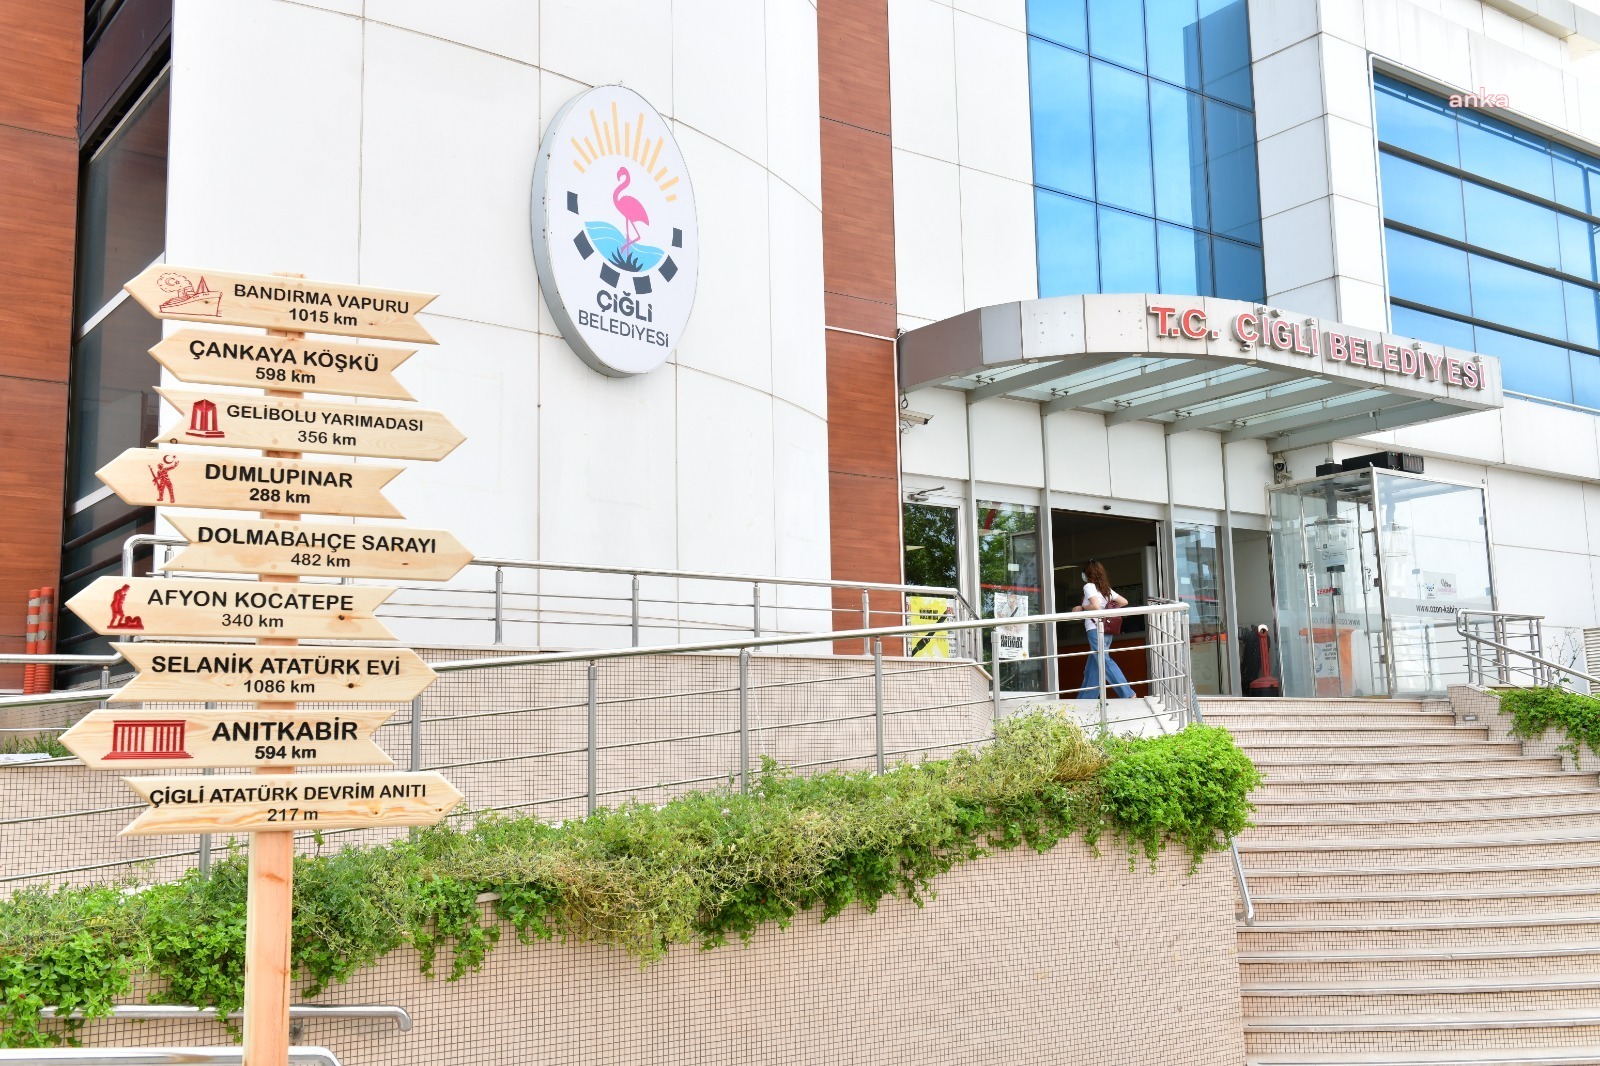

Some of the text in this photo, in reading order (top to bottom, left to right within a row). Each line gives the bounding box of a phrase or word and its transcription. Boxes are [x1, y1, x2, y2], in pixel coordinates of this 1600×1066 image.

[234, 283, 409, 314] BANDIRMA VAPURU
[597, 290, 652, 322] ÇİĞLİ
[288, 307, 358, 327] 1015 km
[579, 310, 668, 347] BELEDİYESİ
[189, 339, 379, 373] ÇANKAYA KÖŞKÜ
[1149, 306, 1220, 340] T.C.
[1326, 331, 1487, 391] BELEDİYESİ
[255, 366, 316, 385] 598 km
[226, 404, 423, 432] GELİBOLU YARIMADASI
[297, 430, 357, 447] 356 km
[205, 463, 353, 489] DUMLUPINAR
[249, 487, 311, 505] 288 km
[198, 526, 436, 554] DOLMABAHÇE SARAYI
[290, 552, 351, 568] 482 km
[147, 588, 354, 612] AFYON KOCATEPE
[221, 613, 284, 628] 340 km
[151, 652, 400, 676] SELANİK ATATÜRK EVİ
[243, 679, 315, 694] 1086 km
[211, 716, 358, 742] ANITKABİR
[254, 745, 317, 760] 594 km
[209, 784, 298, 804] ATATÜRK
[303, 781, 375, 801] DEVRİM
[379, 784, 426, 799] ANITI
[267, 807, 319, 822] 217 m
